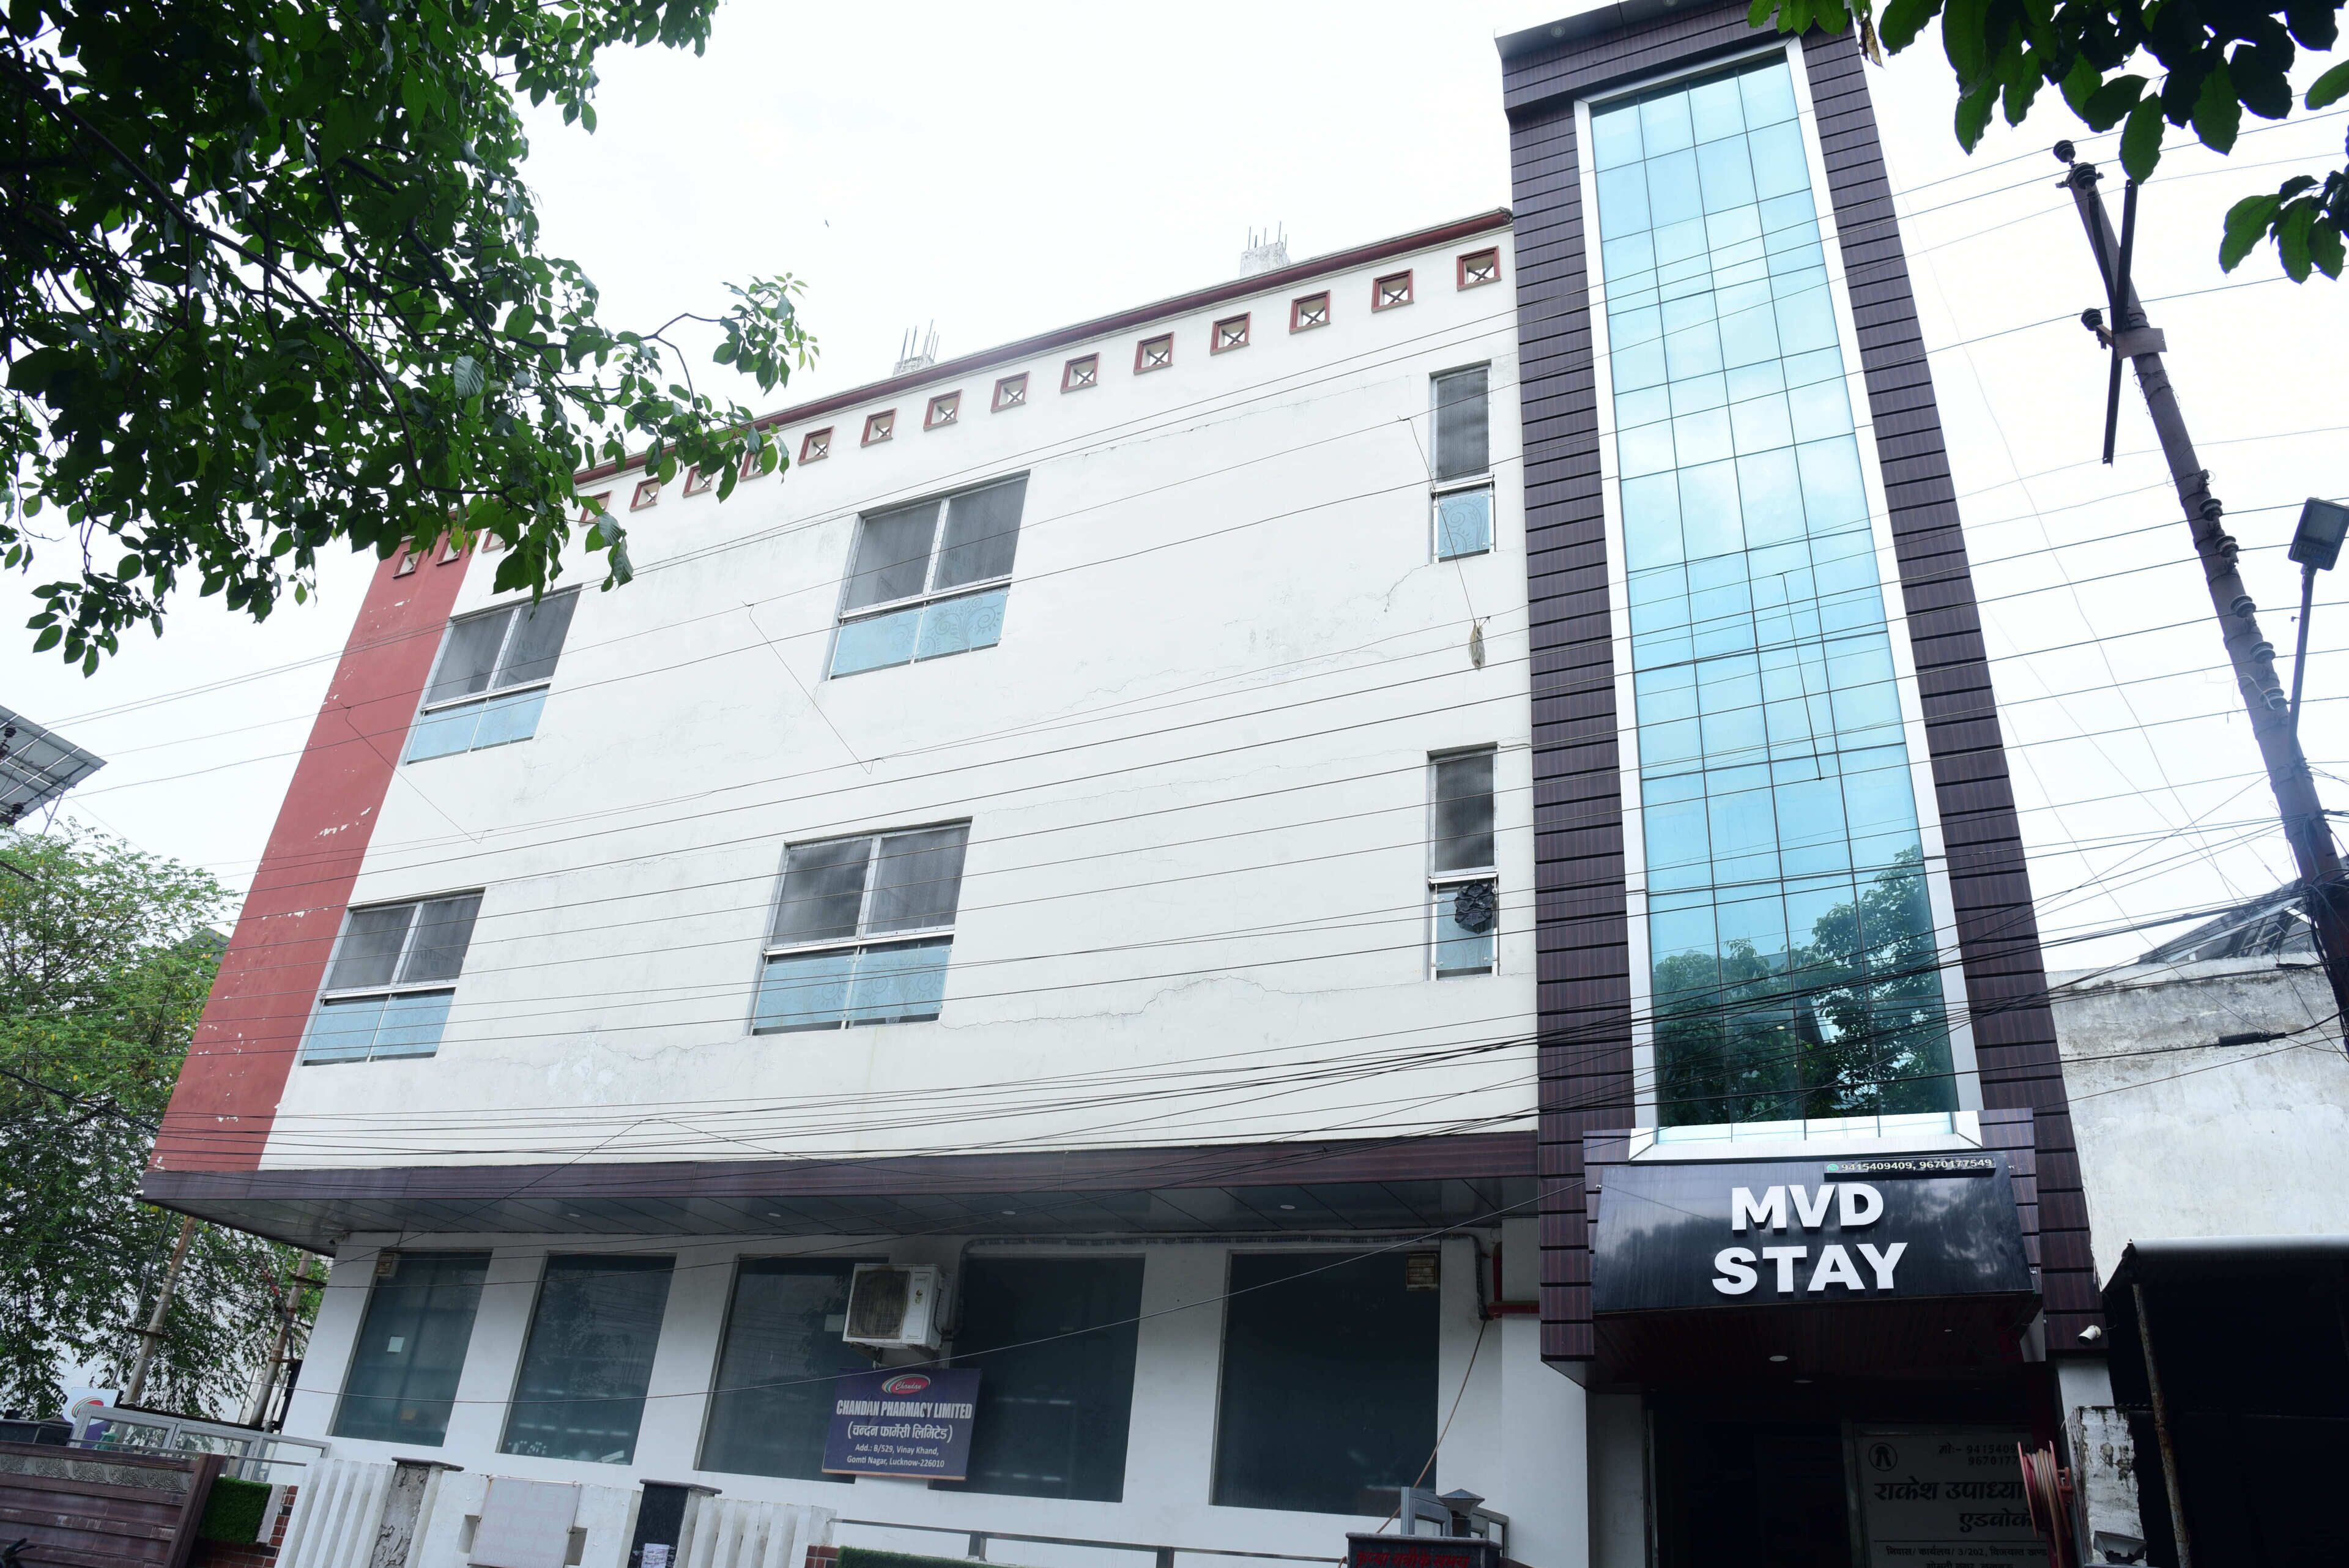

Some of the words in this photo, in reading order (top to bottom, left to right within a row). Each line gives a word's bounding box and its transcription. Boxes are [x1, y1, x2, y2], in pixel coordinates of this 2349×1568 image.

[1841, 1161, 1917, 1171] 9415409409,
[1919, 1158, 1993, 1169] 9670177549
[1731, 1183, 1884, 1232] MVD
[1712, 1242, 1908, 1295] STAY
[895, 1381, 922, 1391] Chandan
[836, 1399, 880, 1416] CHANDAN
[880, 1401, 933, 1418] PHARMACY
[933, 1402, 973, 1419] LIMITED
[847, 1421, 878, 1439] (चन्दन
[912, 1423, 953, 1443] लिमिटेड)
[855, 1443, 872, 1452] Add.:
[873, 1444, 894, 1454] B/529,
[896, 1445, 915, 1455] Vinay
[916, 1446, 939, 1456] Khand,
[1967, 1443, 2032, 1454] 94154090
[847, 1455, 867, 1464] Gomti
[867, 1456, 888, 1466] Nagar,
[889, 1457, 945, 1468] Lucknow-226010
[1968, 1455, 2019, 1465] 9670177
[1874, 1476, 1939, 1500] राकेश
[1944, 1481, 2026, 1500] उपाध्या
[1959, 1507, 2032, 1533] एडवोके
